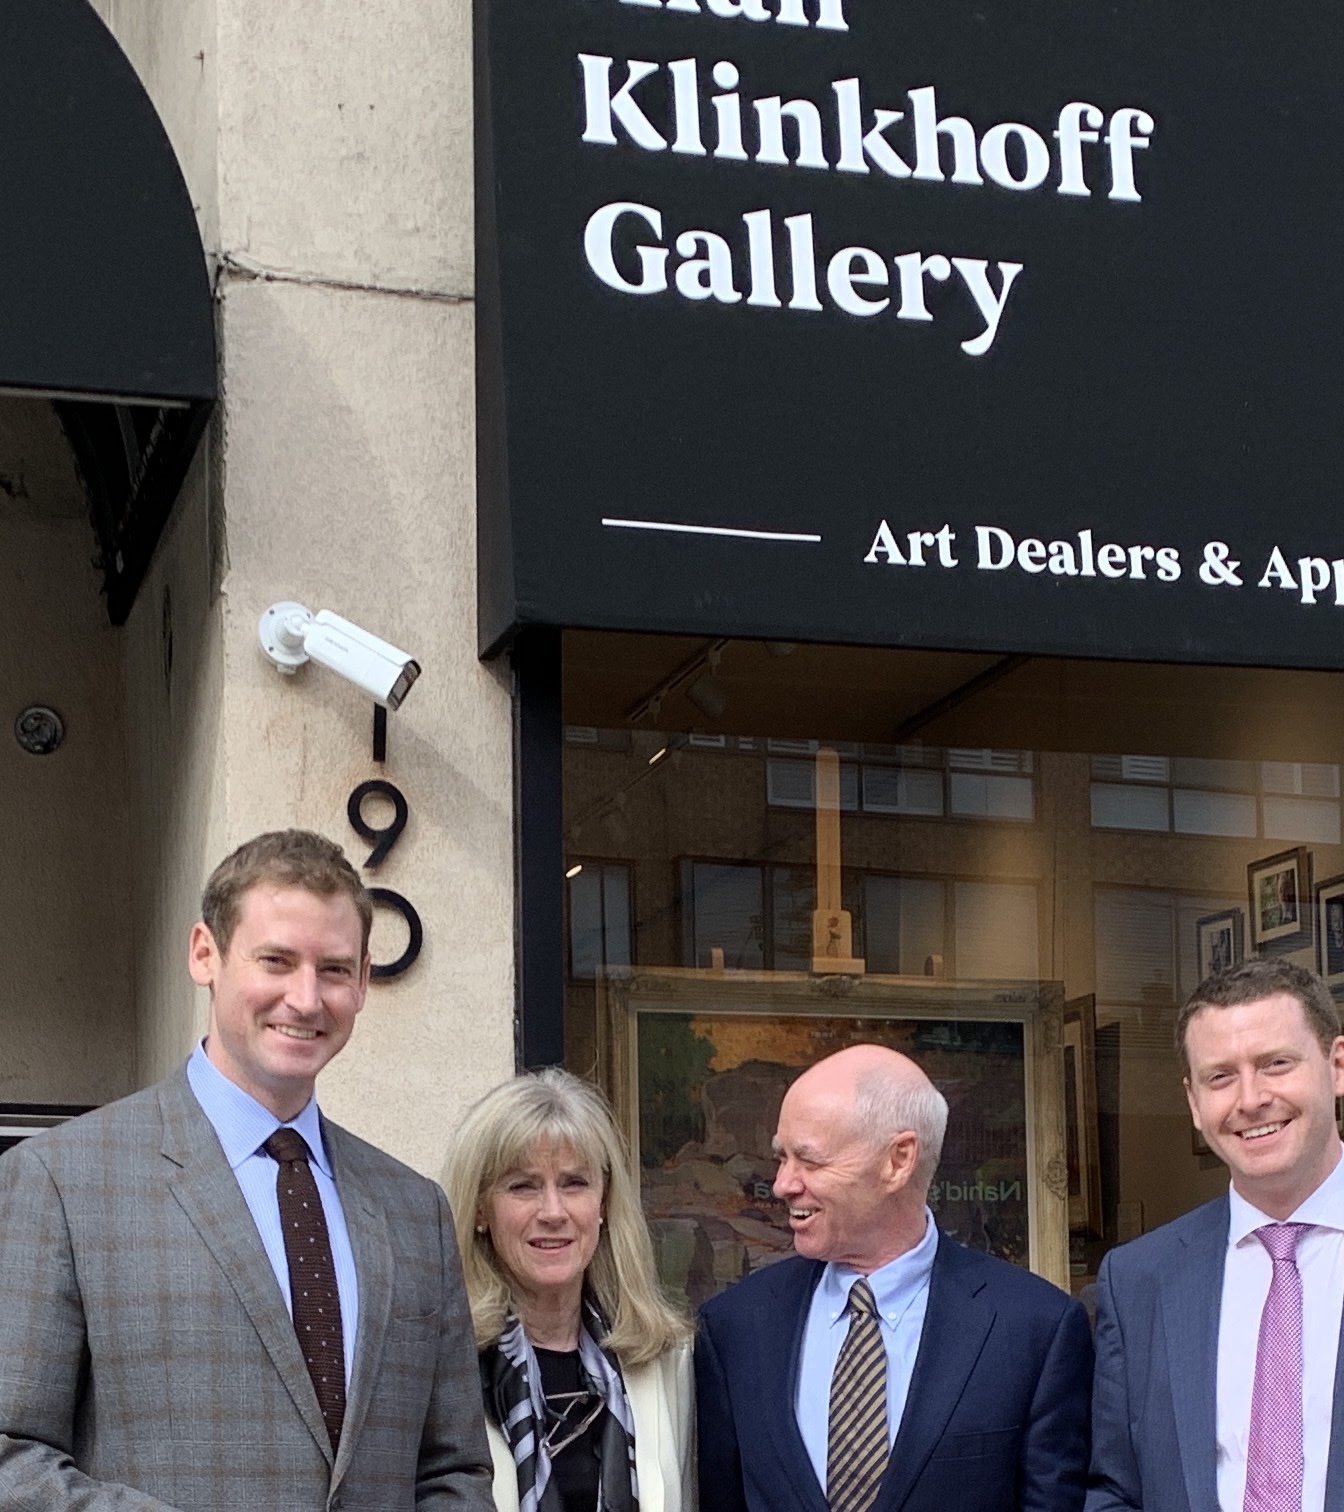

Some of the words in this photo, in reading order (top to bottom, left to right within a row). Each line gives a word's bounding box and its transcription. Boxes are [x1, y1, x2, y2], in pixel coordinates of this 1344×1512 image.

[577, 53, 1155, 207] Klinkhoff
[583, 202, 1024, 356] Gallery
[863, 519, 959, 568] Art
[974, 525, 1182, 582] Dealers
[1198, 541, 1243, 586] &
